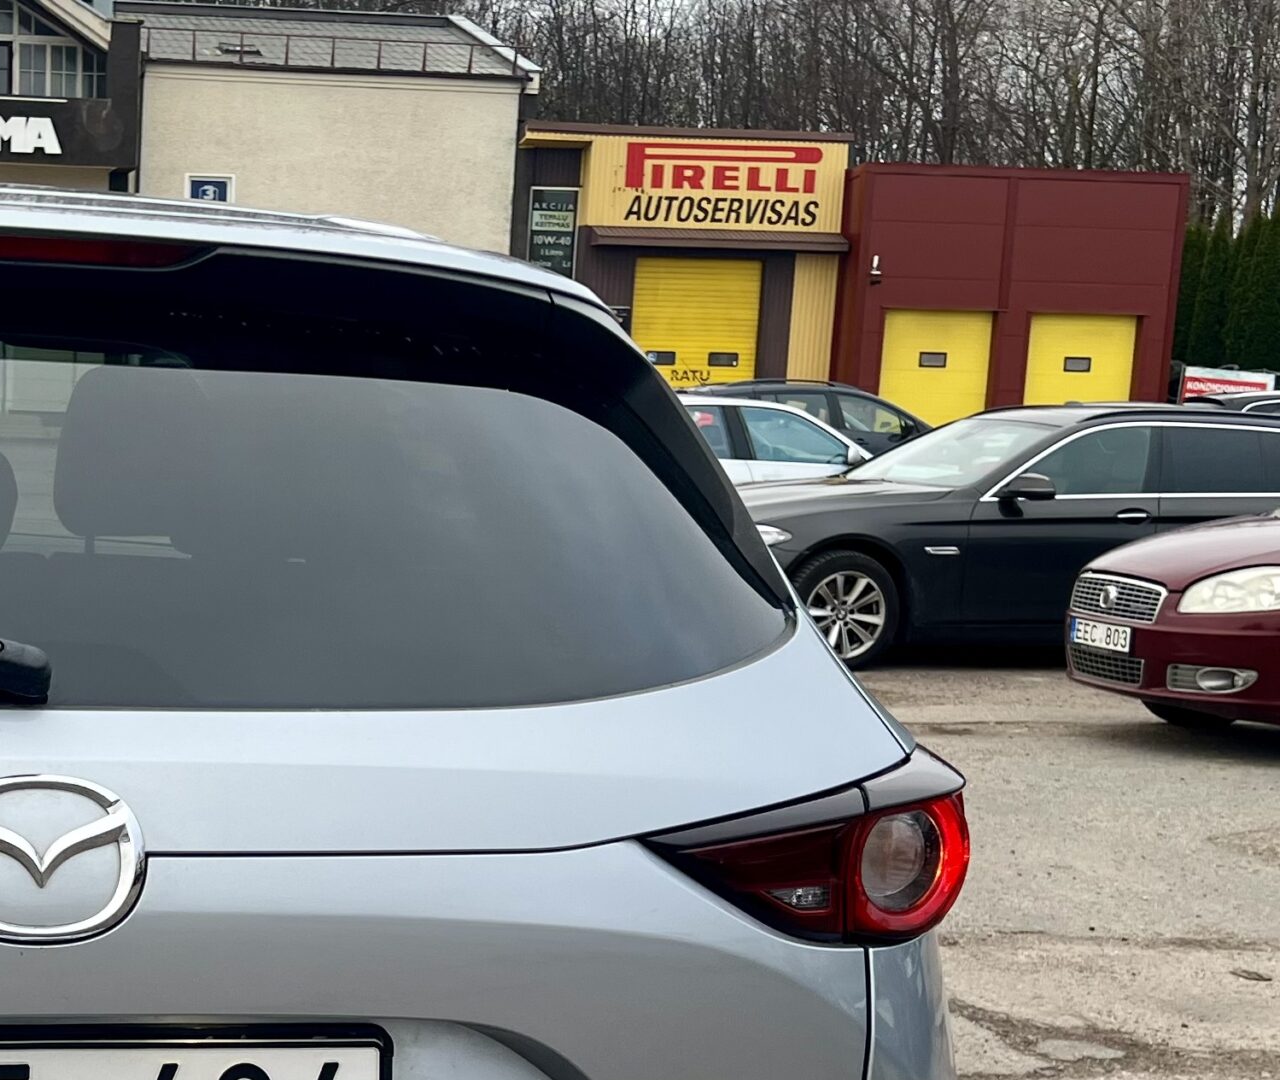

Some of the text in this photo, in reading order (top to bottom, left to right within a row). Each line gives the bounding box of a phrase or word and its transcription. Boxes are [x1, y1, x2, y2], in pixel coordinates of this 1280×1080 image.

[625, 142, 824, 194] PIRELLI
[533, 202, 575, 211] AKCIJA
[624, 195, 819, 227] AUTOSERVISAS
[533, 235, 572, 246] 10W-40
[1075, 620, 1128, 649] EEC 803
